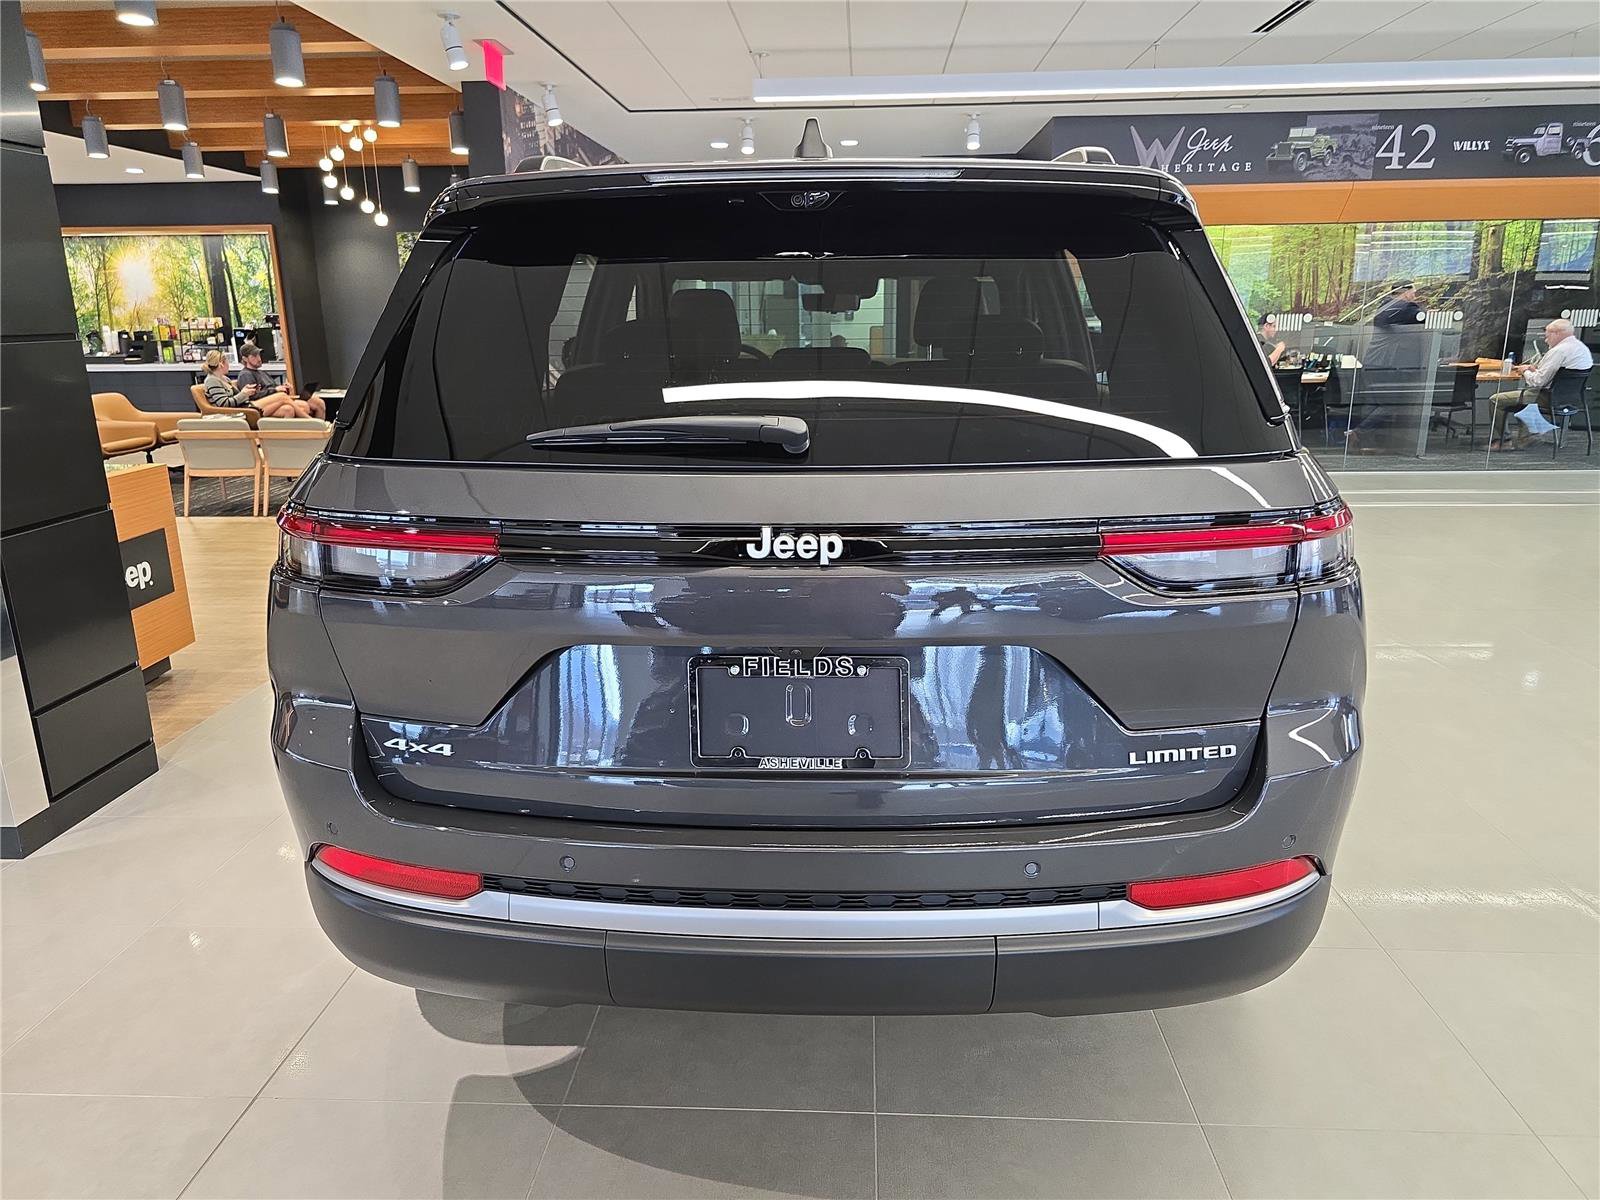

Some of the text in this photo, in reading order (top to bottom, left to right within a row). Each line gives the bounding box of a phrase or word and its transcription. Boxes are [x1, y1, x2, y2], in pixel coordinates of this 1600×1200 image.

[1181, 127, 1234, 165] Jeep
[1375, 124, 1436, 169] 42
[1453, 140, 1491, 151] WILLYS
[1161, 162, 1253, 173] HERITAGE
[746, 525, 844, 566] Jeep
[742, 656, 855, 678] FIELDS
[383, 737, 456, 757] 4x4
[1129, 744, 1237, 765] LIMITED
[758, 756, 843, 769] ASHEVILLE
